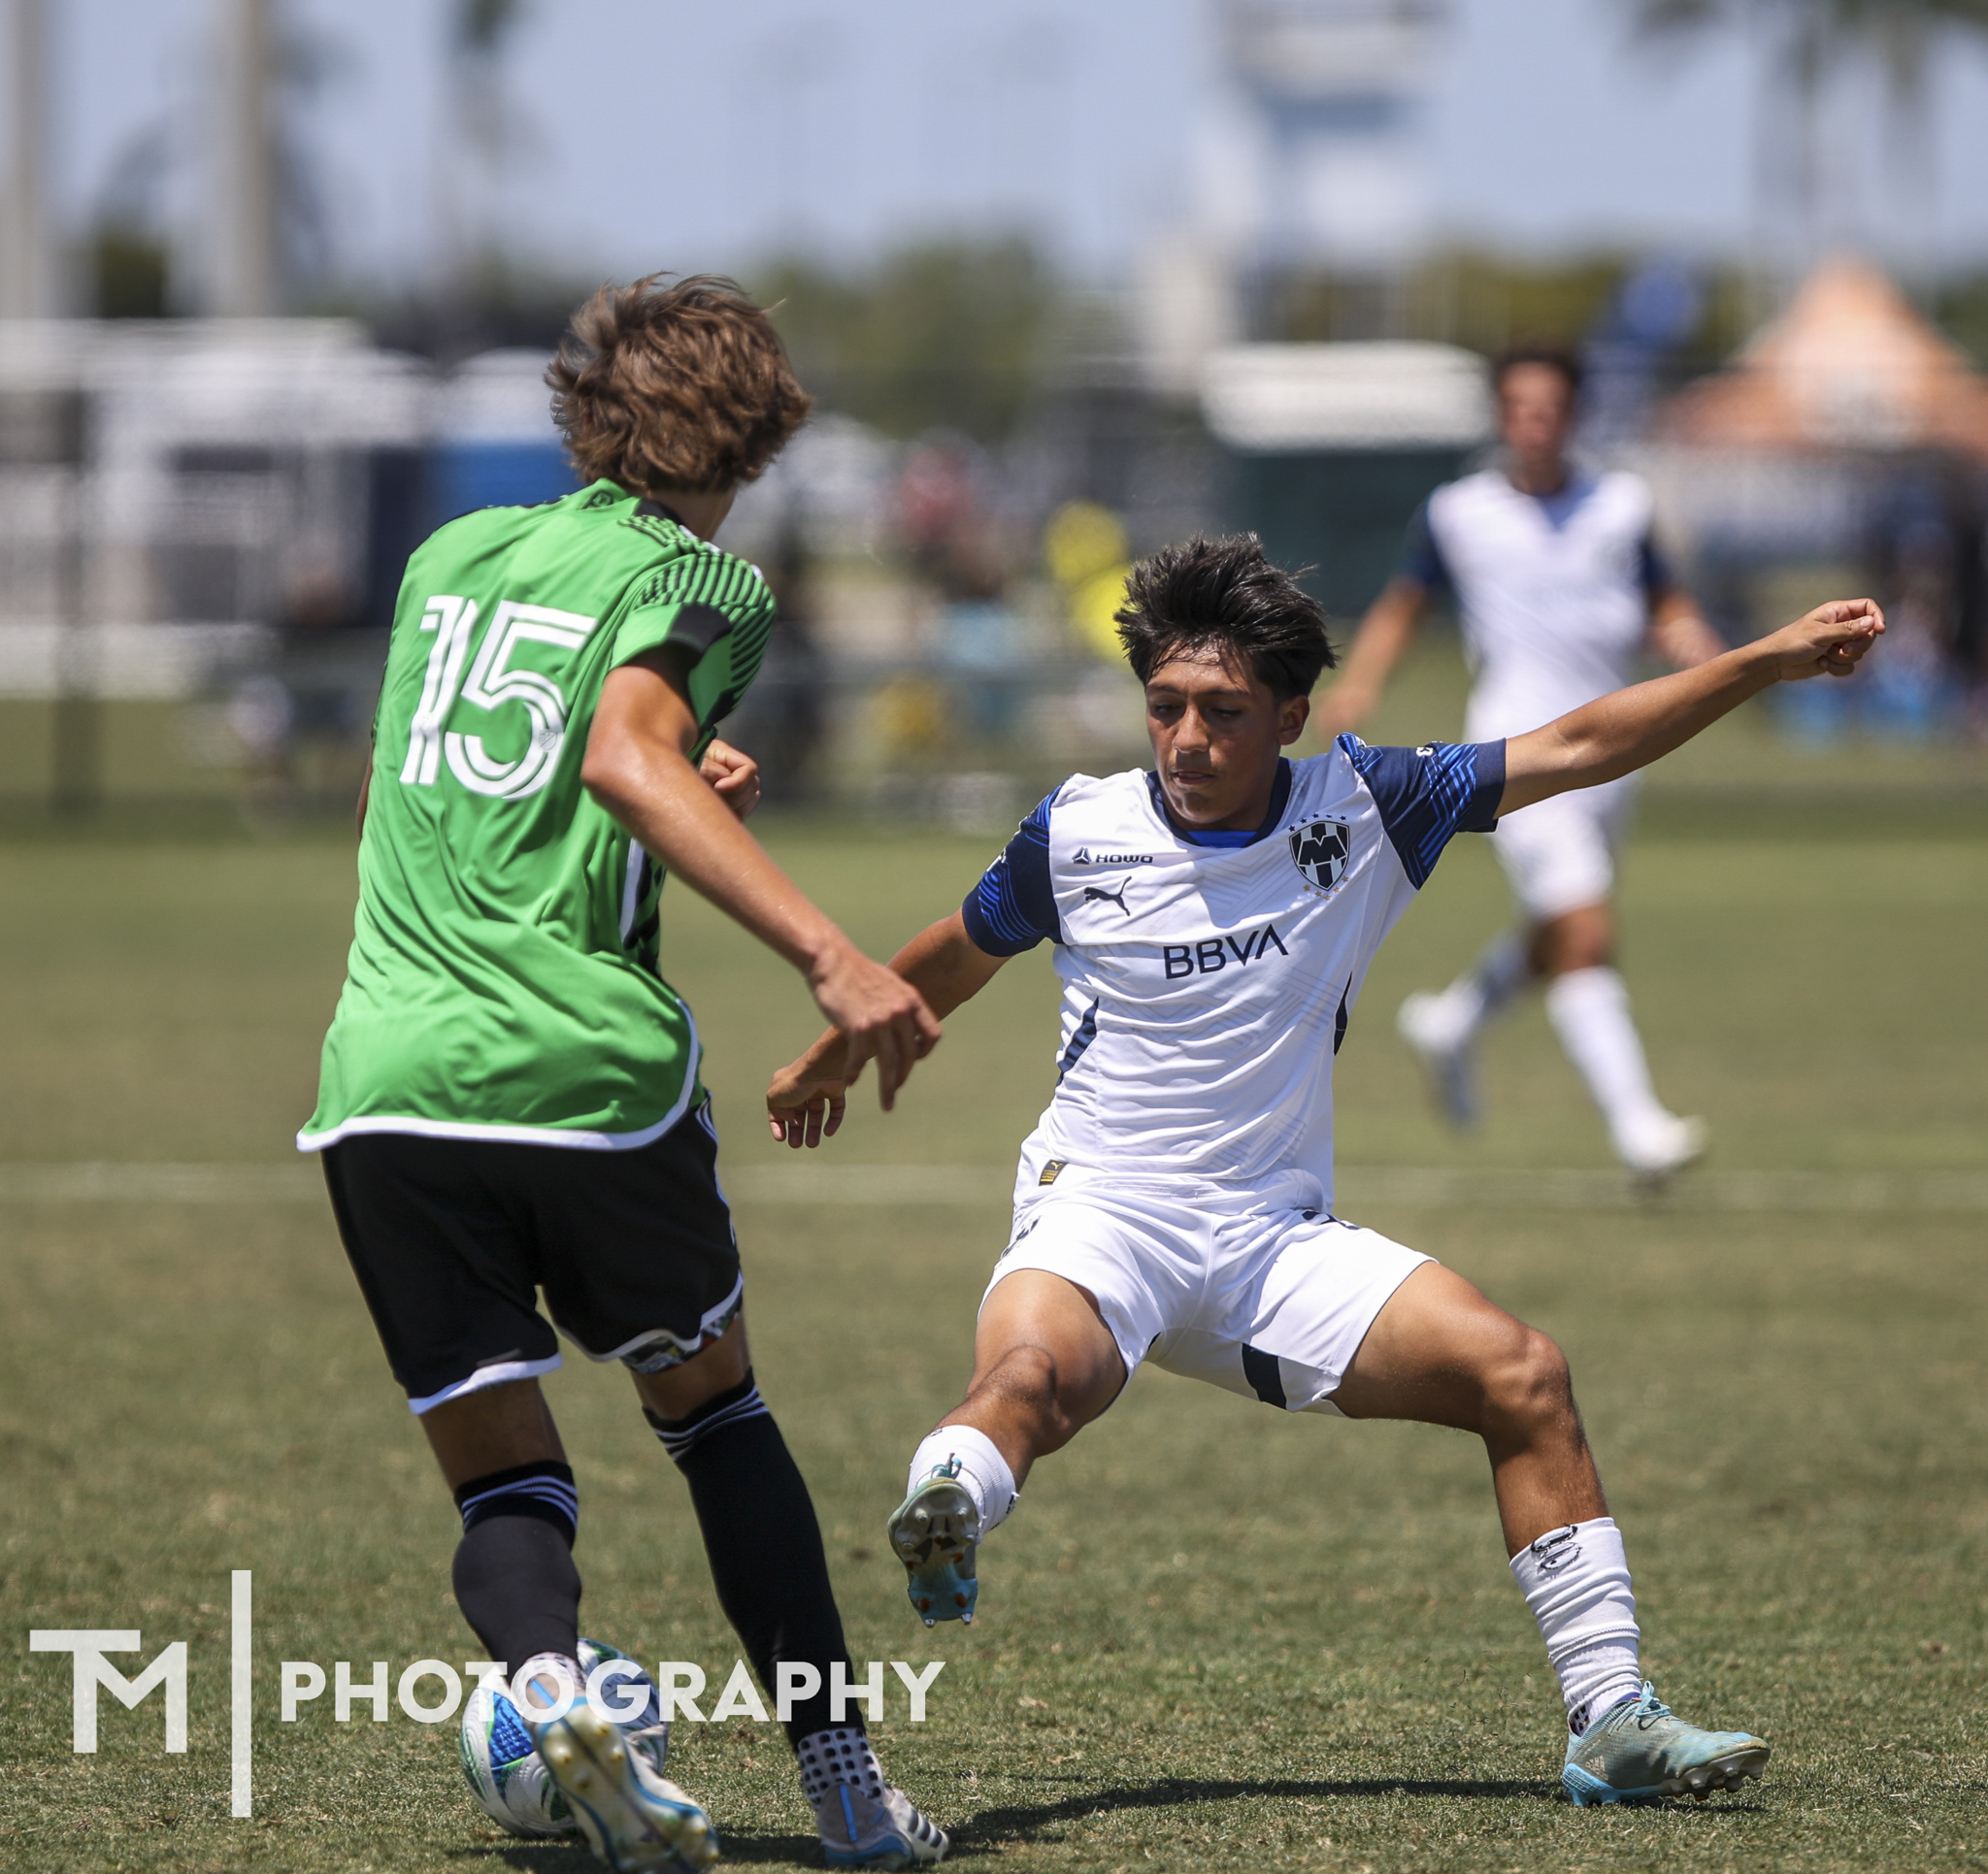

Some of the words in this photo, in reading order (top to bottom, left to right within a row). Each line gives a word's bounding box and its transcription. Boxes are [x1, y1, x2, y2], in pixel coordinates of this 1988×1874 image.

[399, 595, 598, 800] 15
[1096, 854, 1153, 864] HOWO
[1163, 924, 1289, 979] BBVA
